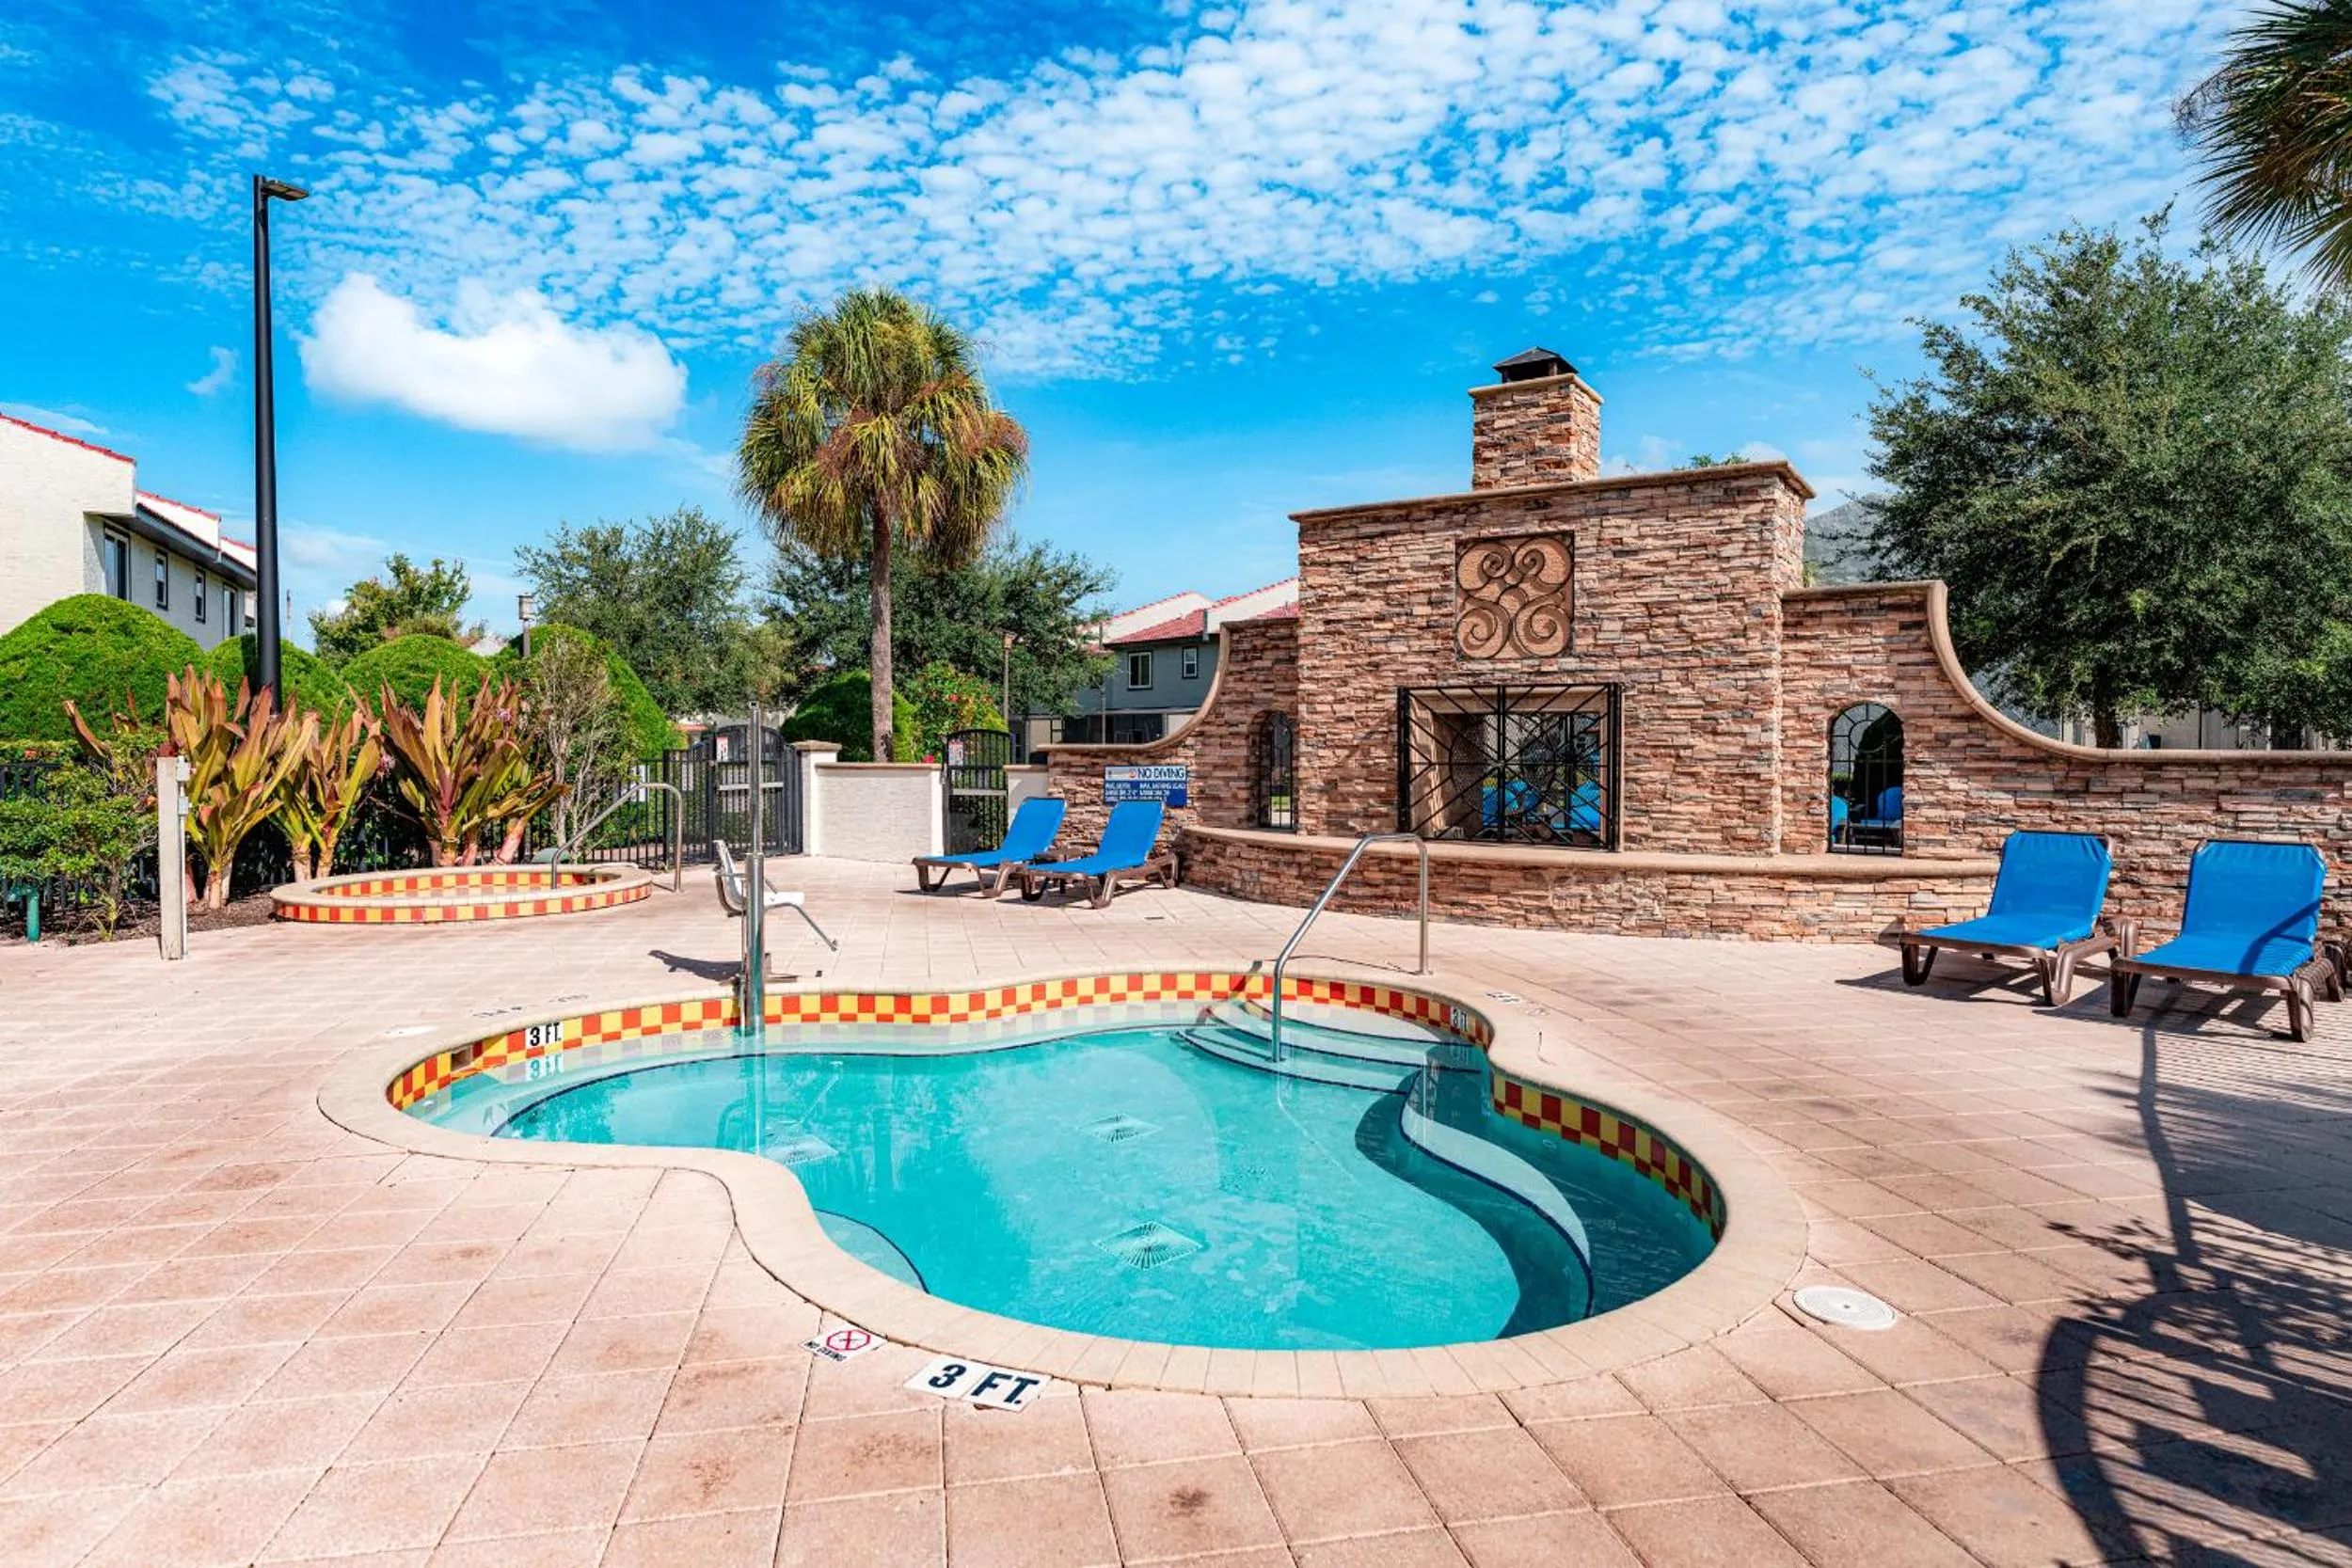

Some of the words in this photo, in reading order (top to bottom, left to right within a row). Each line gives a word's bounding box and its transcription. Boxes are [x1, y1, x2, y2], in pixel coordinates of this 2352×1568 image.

[1138, 768, 1152, 779] NO
[1153, 768, 1185, 779] DIVING
[530, 1026, 540, 1047] 3
[546, 1022, 562, 1044] FT.
[928, 1364, 967, 1388] 3
[971, 1371, 1040, 1405] FT.
